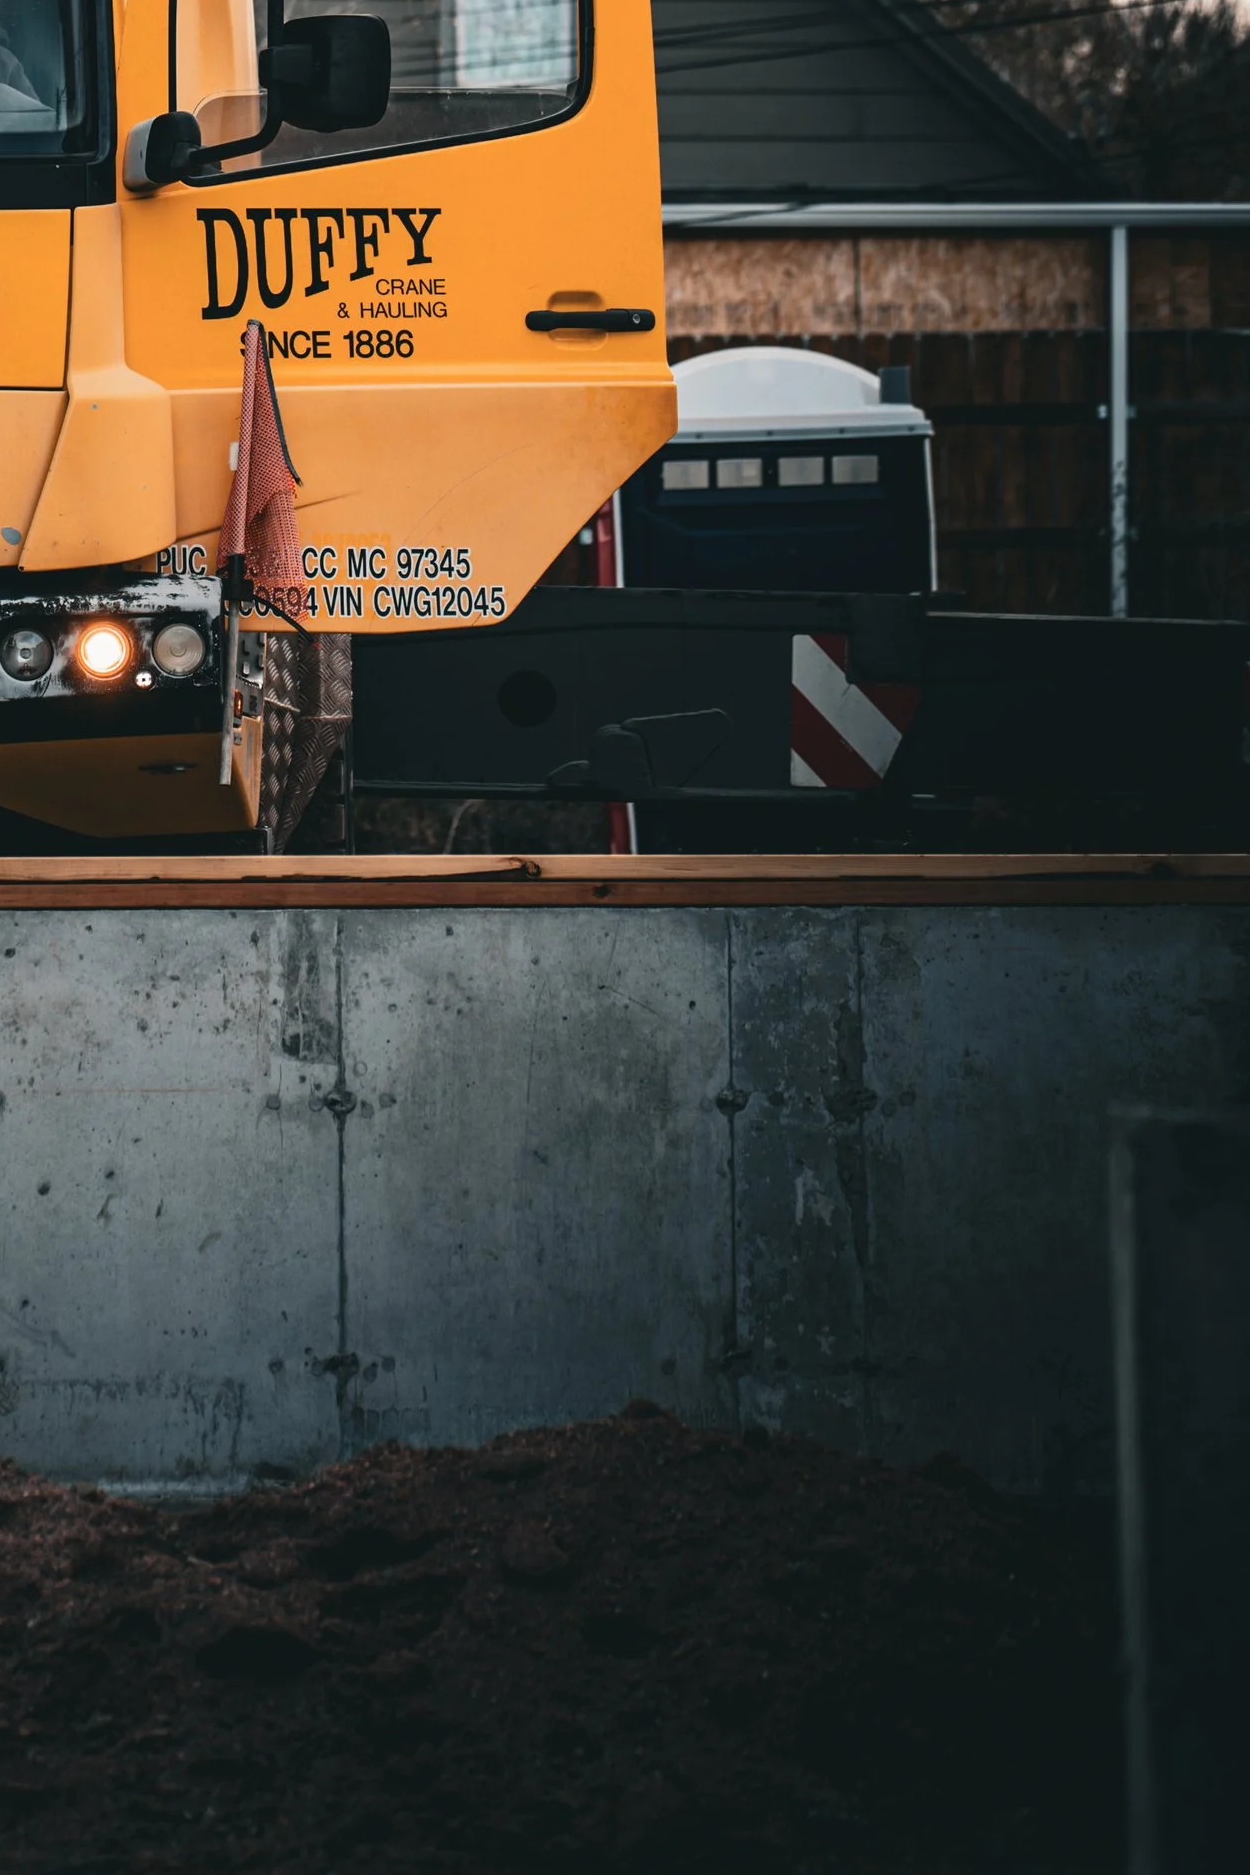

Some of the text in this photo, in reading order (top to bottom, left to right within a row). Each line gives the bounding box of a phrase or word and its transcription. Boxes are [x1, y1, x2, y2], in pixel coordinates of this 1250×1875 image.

[196, 208, 442, 320] DUFFY
[375, 278, 447, 296] CRANE
[337, 301, 448, 319] & HAULING
[239, 329, 415, 359] NCE 1886
[156, 545, 207, 575] PUC
[346, 546, 387, 580] MC
[396, 546, 472, 581] 97345
[322, 585, 364, 618] VIN
[373, 585, 507, 619] CWG12045
